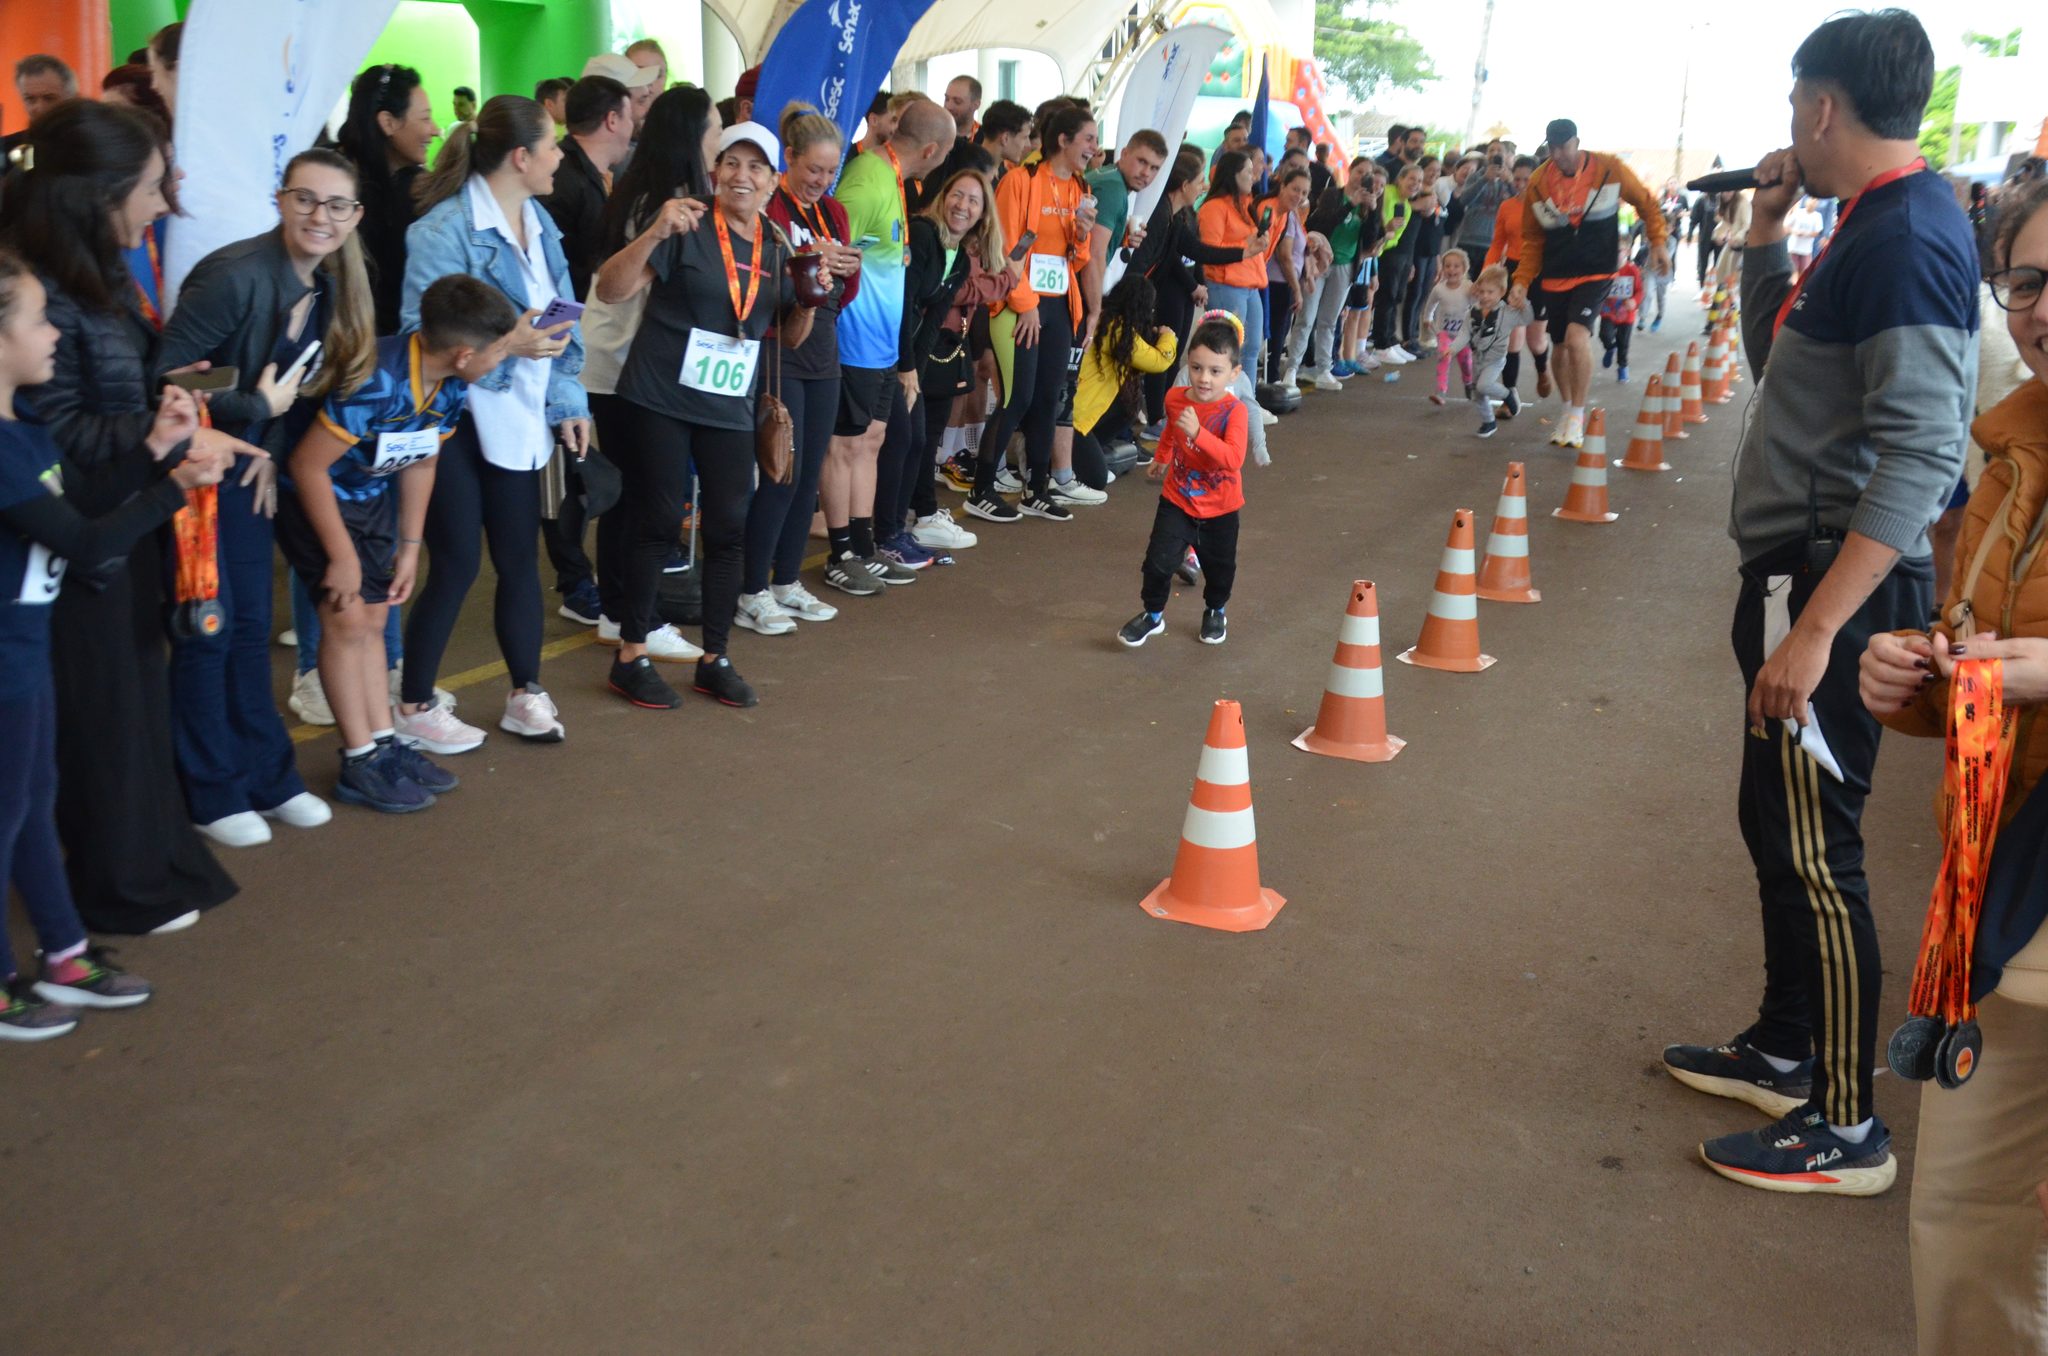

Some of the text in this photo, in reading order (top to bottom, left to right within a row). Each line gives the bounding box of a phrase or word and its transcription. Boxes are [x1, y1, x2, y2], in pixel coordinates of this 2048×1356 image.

[1036, 269, 1064, 290] 261
[696, 356, 746, 391] 106
[1805, 1147, 1843, 1171] FILA
